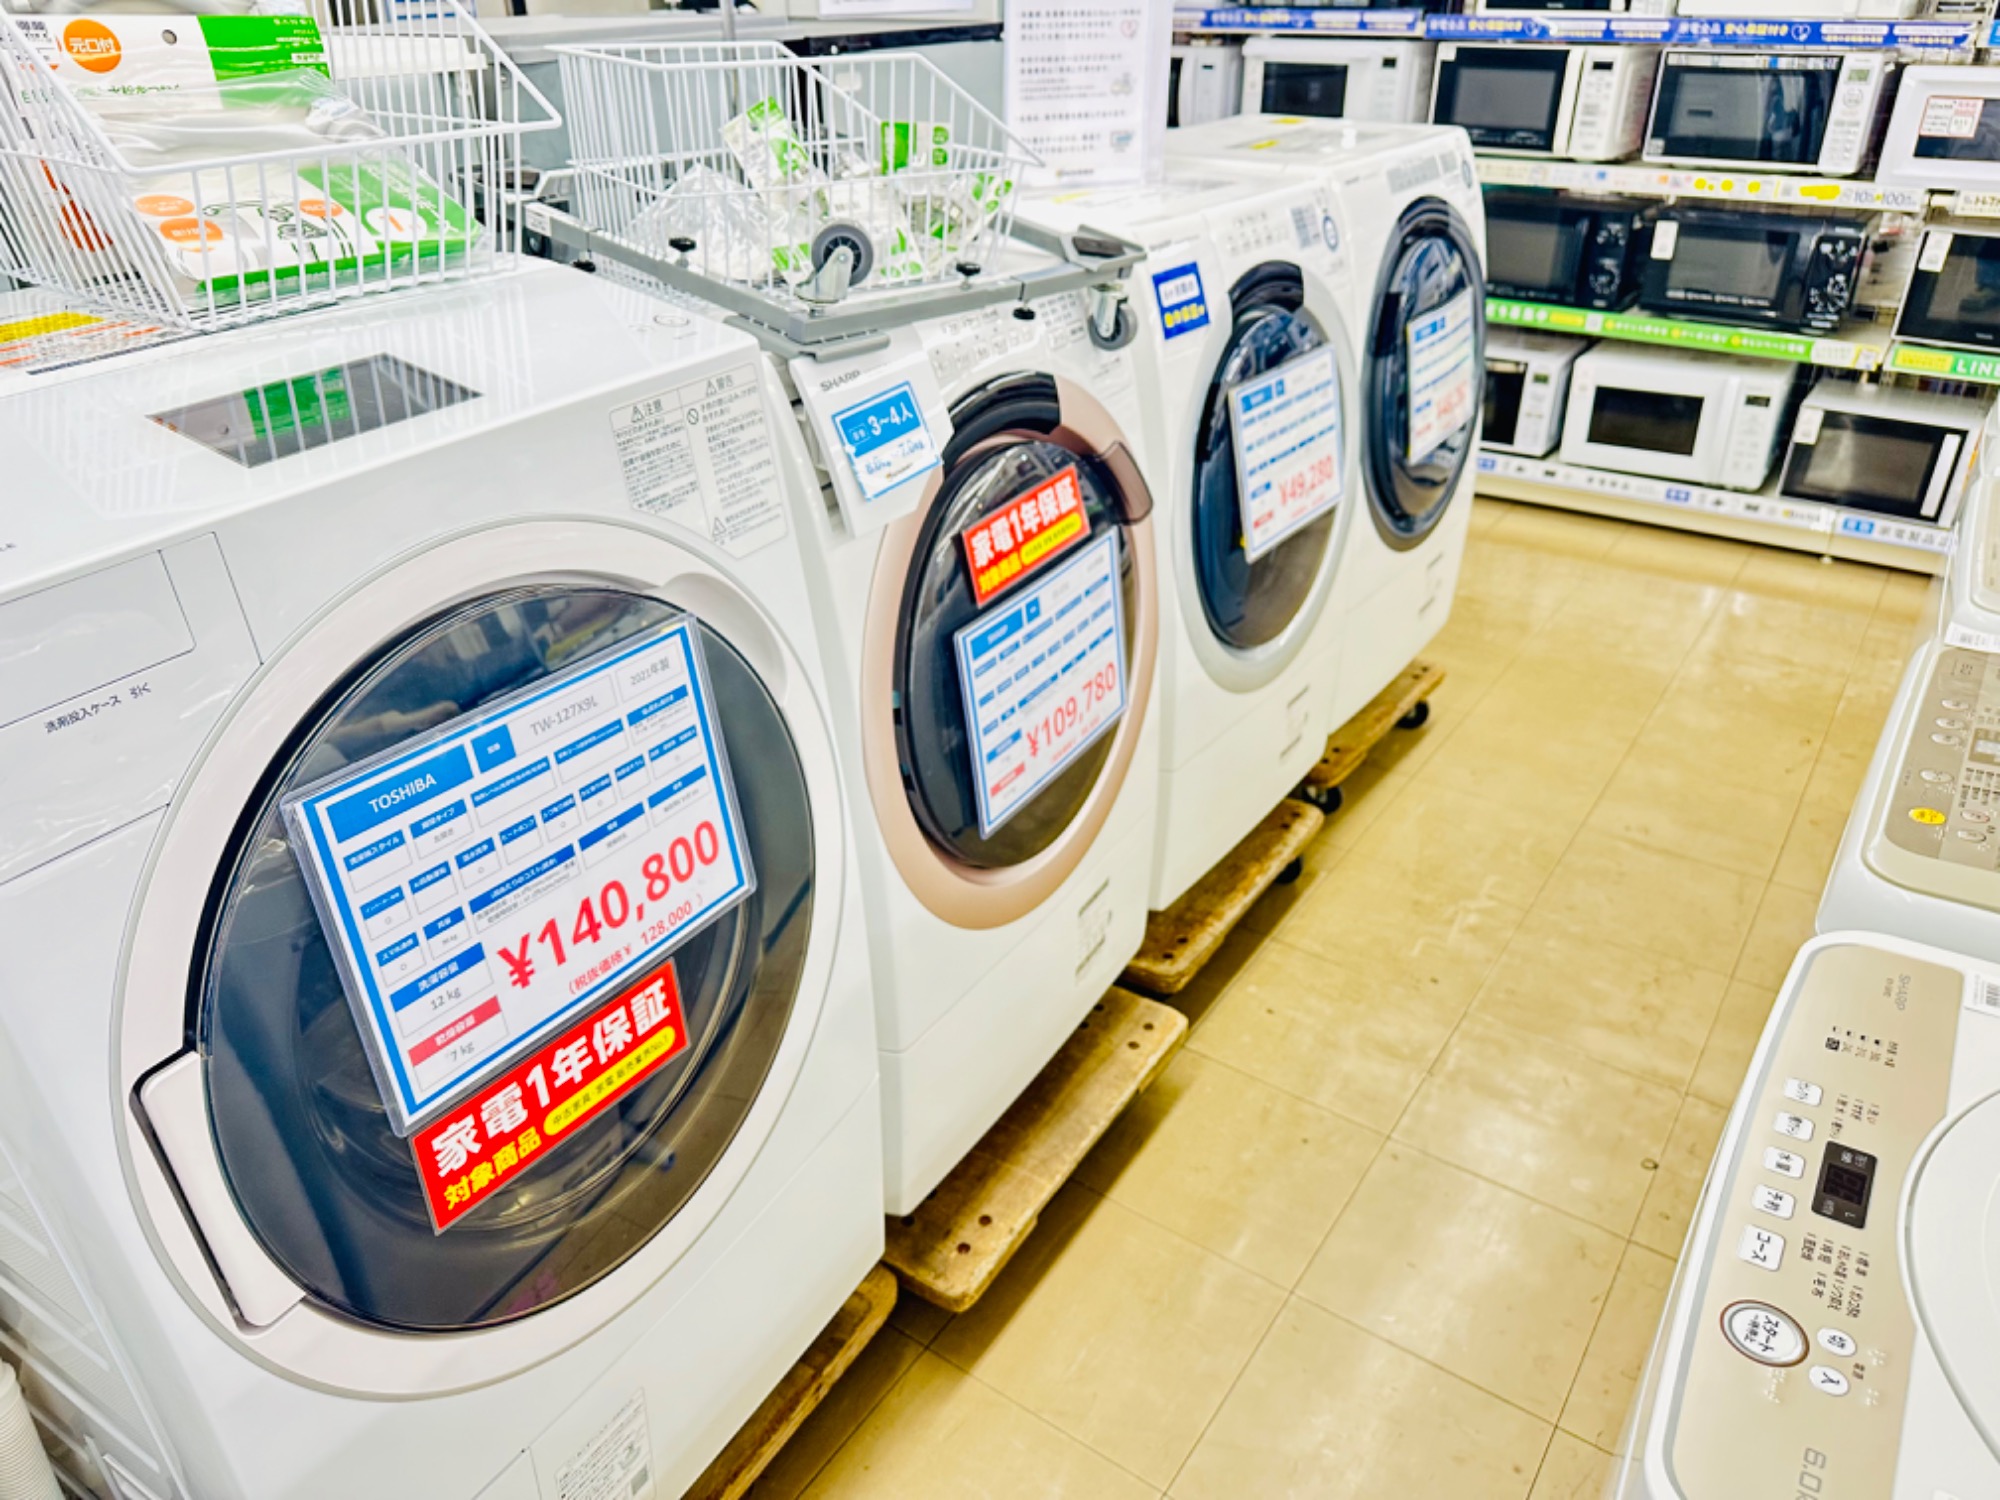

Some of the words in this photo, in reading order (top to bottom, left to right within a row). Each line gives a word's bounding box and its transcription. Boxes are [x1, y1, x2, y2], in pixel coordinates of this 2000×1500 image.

[68, 37, 118, 54] 元口付
[820, 370, 861, 392] SHARP
[44, 694, 122, 735] 洗剤投入ケース
[128, 682, 152, 700] 引く
[1026, 661, 1117, 759] ¥109,780
[367, 772, 438, 814] TOSHIBA
[496, 819, 720, 990] ¥140,800
[431, 977, 672, 1179] 家電1年保証
[444, 1126, 543, 1212] 対象商品
[1750, 1230, 1772, 1264] コース
[1758, 1314, 1781, 1354] スタート
[1820, 1370, 1842, 1387] 入
